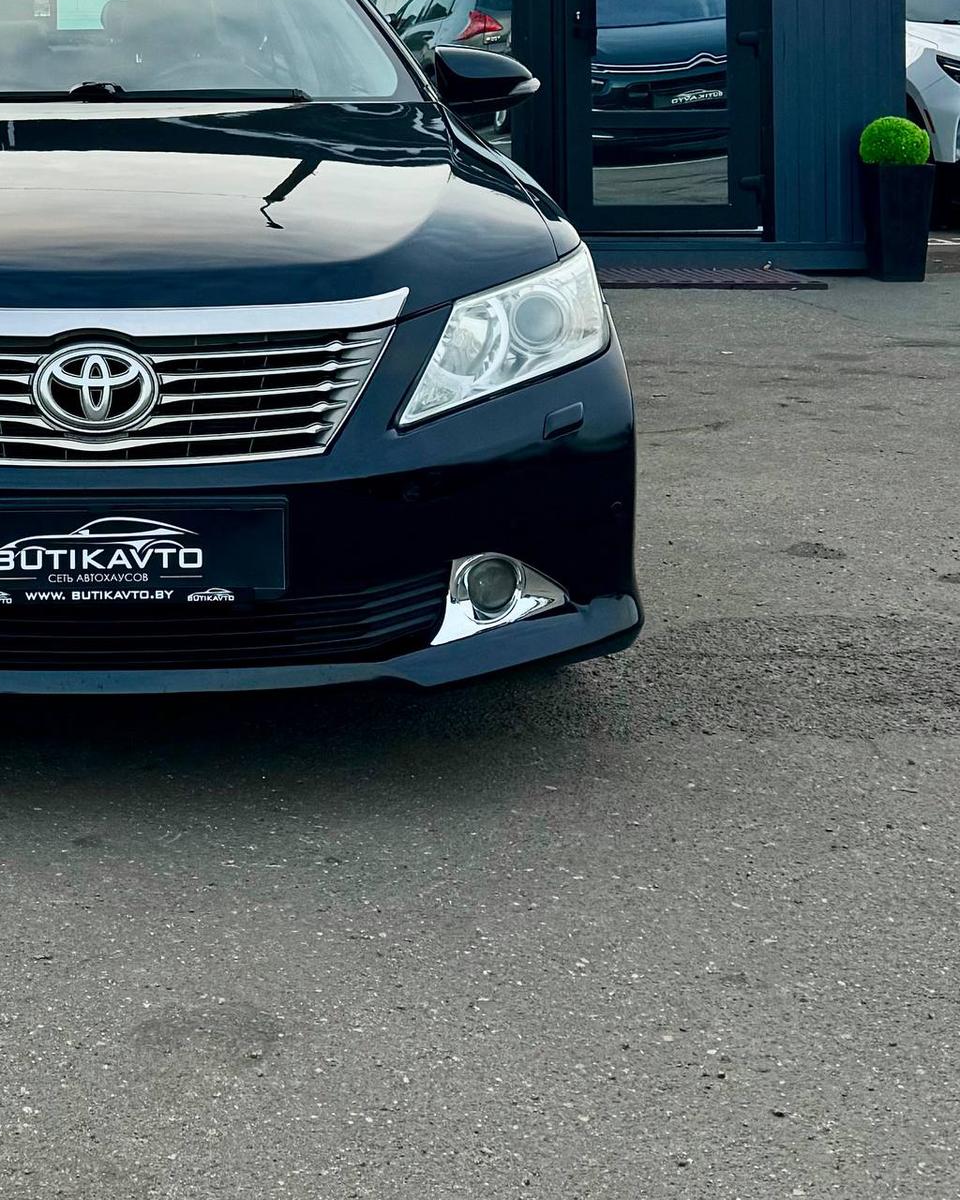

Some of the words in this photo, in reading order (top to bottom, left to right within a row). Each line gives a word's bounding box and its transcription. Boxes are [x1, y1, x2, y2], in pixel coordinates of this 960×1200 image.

[48, 574, 73, 583] СЕТЬ
[76, 573, 149, 583] АВТОХАУСОВ
[25, 591, 66, 601] WWW.
[72, 590, 174, 601] BUTIKAVTO.BY
[187, 594, 235, 602] BUTIKAVTO
